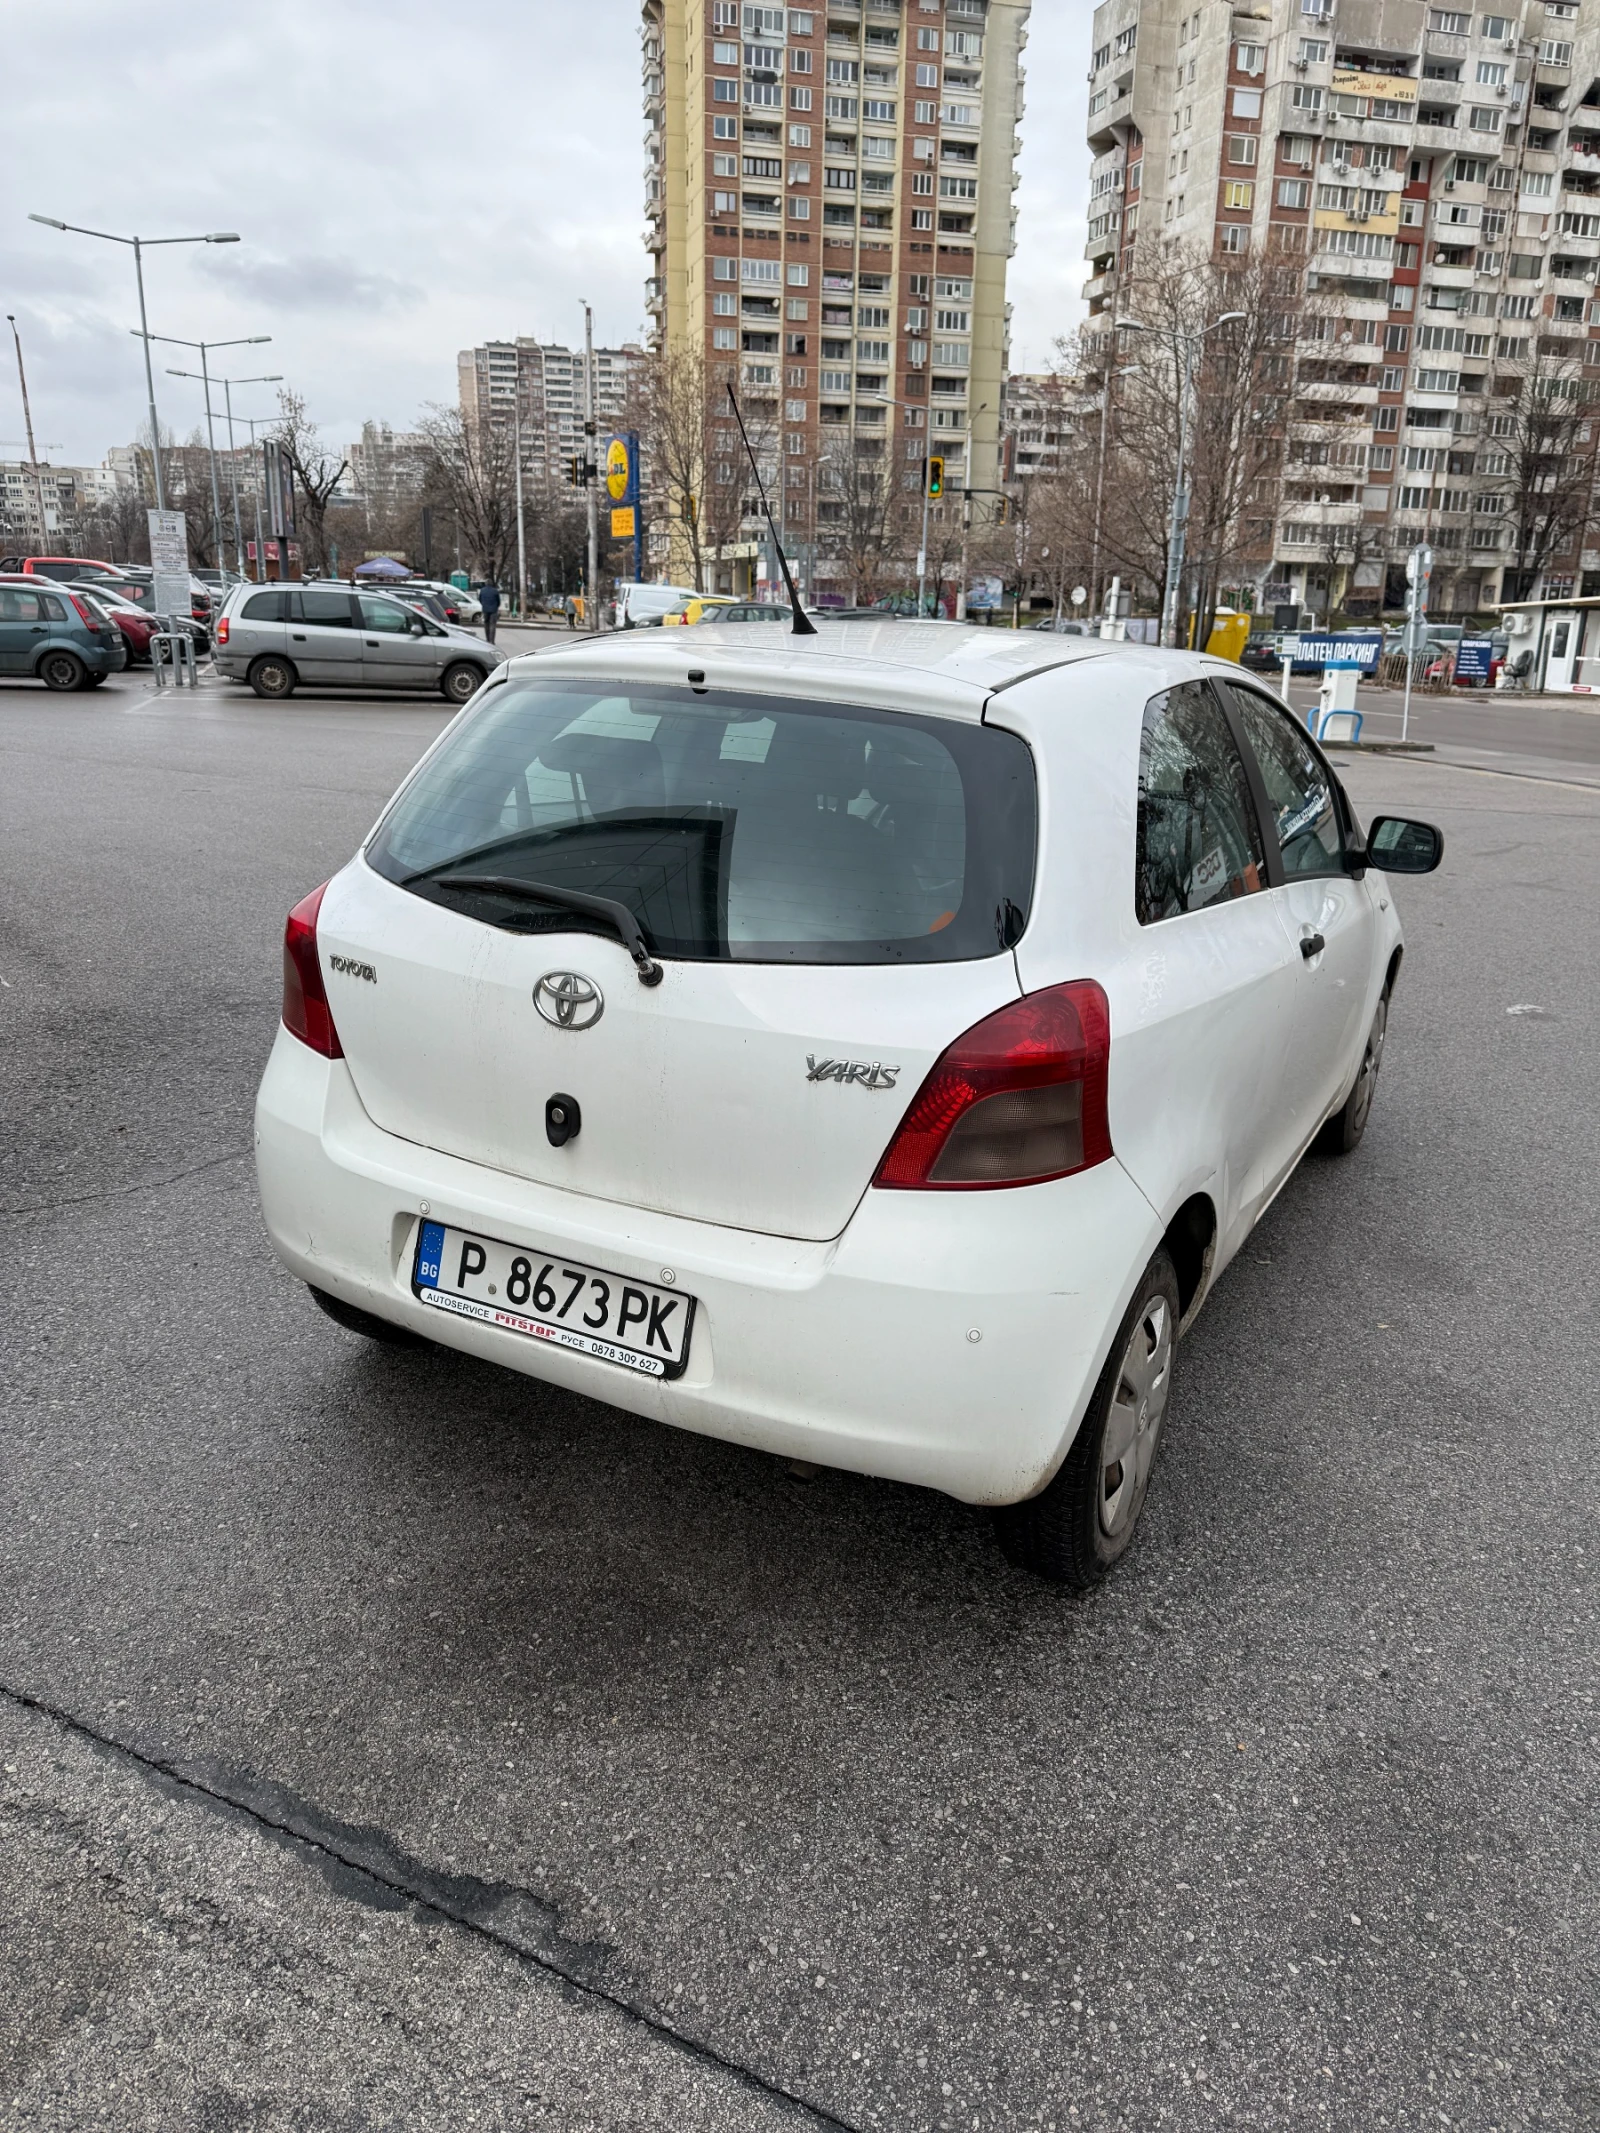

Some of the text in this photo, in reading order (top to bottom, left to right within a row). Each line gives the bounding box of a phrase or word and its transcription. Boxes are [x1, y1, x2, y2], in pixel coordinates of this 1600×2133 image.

[1333, 643, 1379, 663] ПАРКИНГ
[329, 953, 377, 984] TOYOTA
[421, 1261, 438, 1278] BG
[457, 1240, 679, 1353] P 8673 PK
[427, 1293, 490, 1318] AUTOSERVICE
[591, 1343, 615, 1358] 0878
[618, 1352, 637, 1365] 309
[639, 1360, 658, 1372] 627
